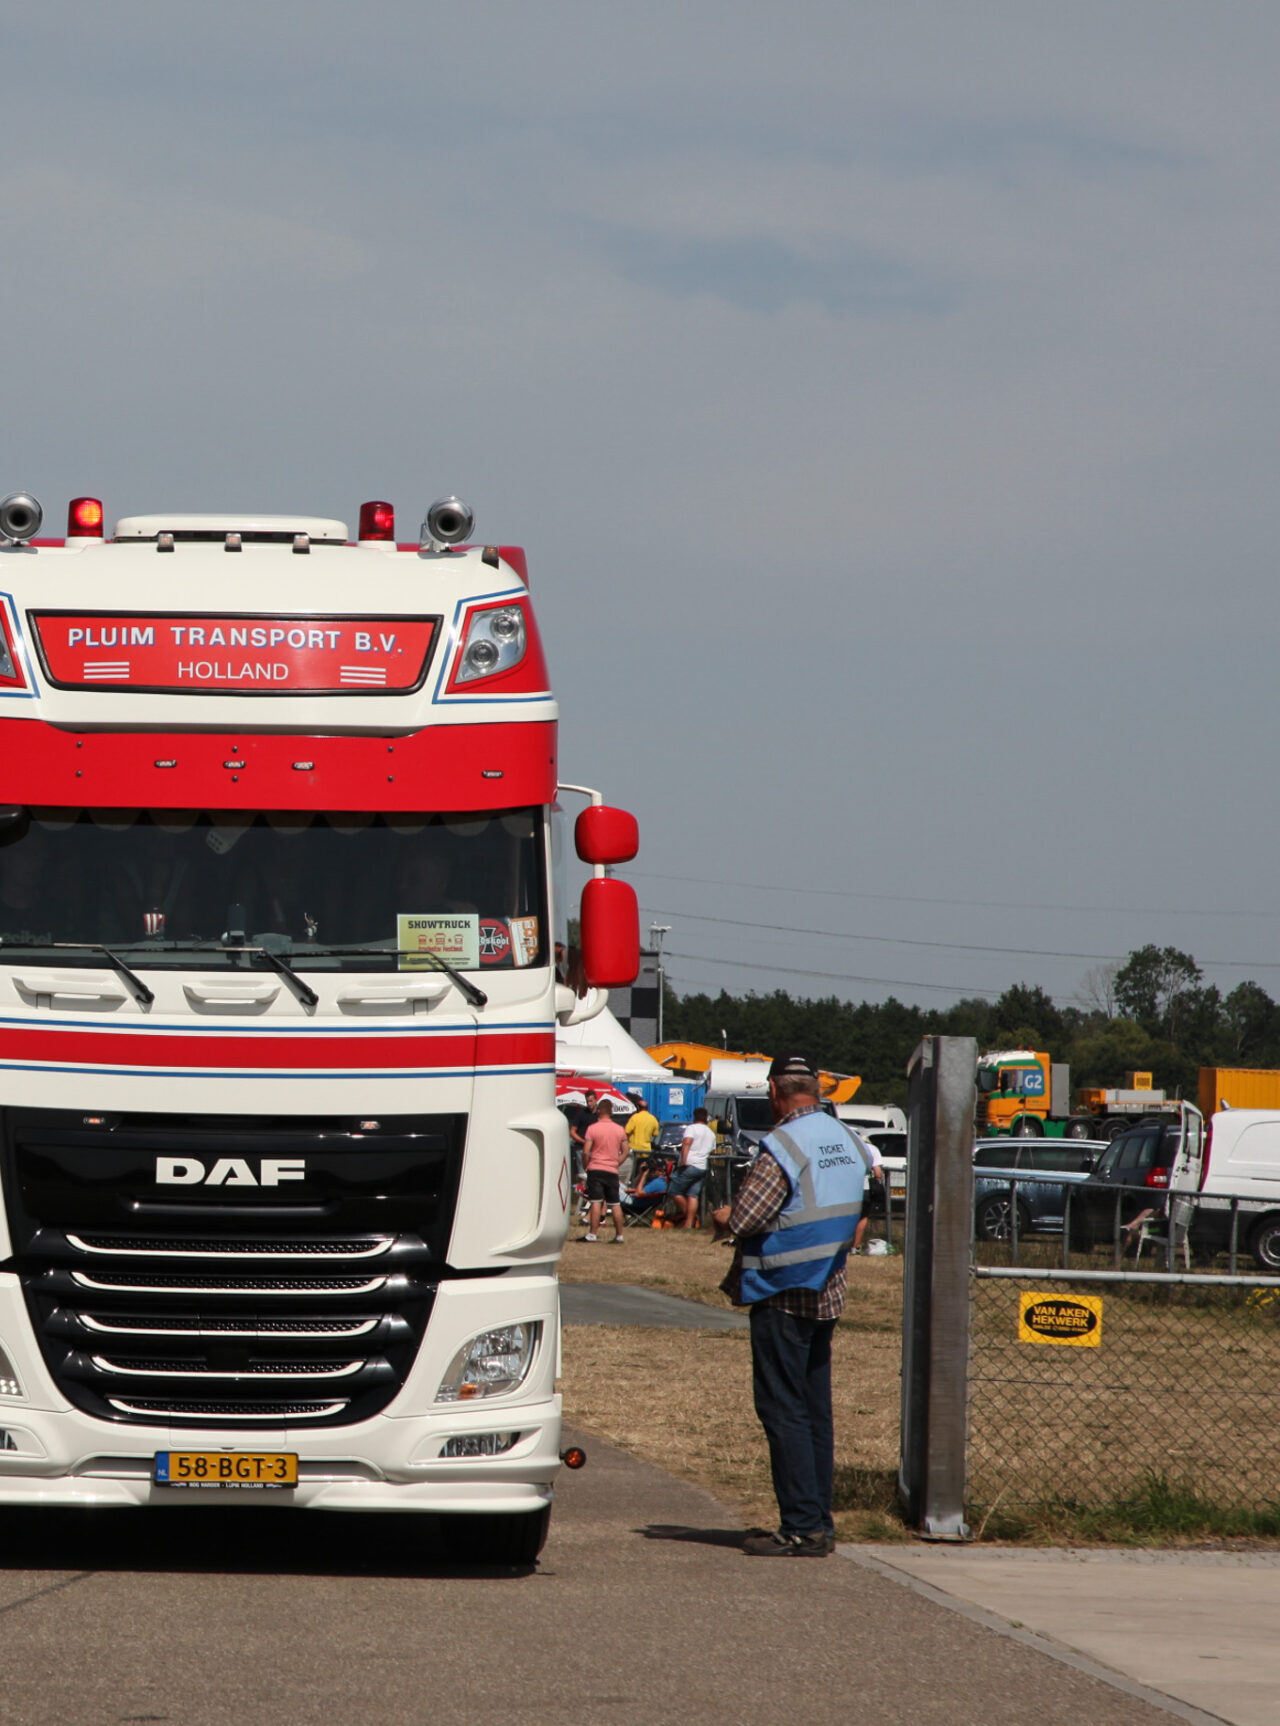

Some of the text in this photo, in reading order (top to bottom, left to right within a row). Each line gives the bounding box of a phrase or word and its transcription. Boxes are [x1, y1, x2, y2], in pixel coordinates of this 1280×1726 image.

[68, 627, 404, 653] PLUIM TRANSPORT B.V.
[177, 661, 289, 680] HOLLAND
[408, 920, 470, 929] SHOWTRUCK
[1024, 1075, 1042, 1089] G2
[819, 1144, 845, 1155] TICKET
[818, 1156, 856, 1169] CONTROL
[156, 1157, 305, 1186] DAF
[1033, 1306, 1089, 1317] VAN AKEN
[1032, 1315, 1088, 1327] HEKWERK
[178, 1457, 287, 1478] 58-BGT-3
